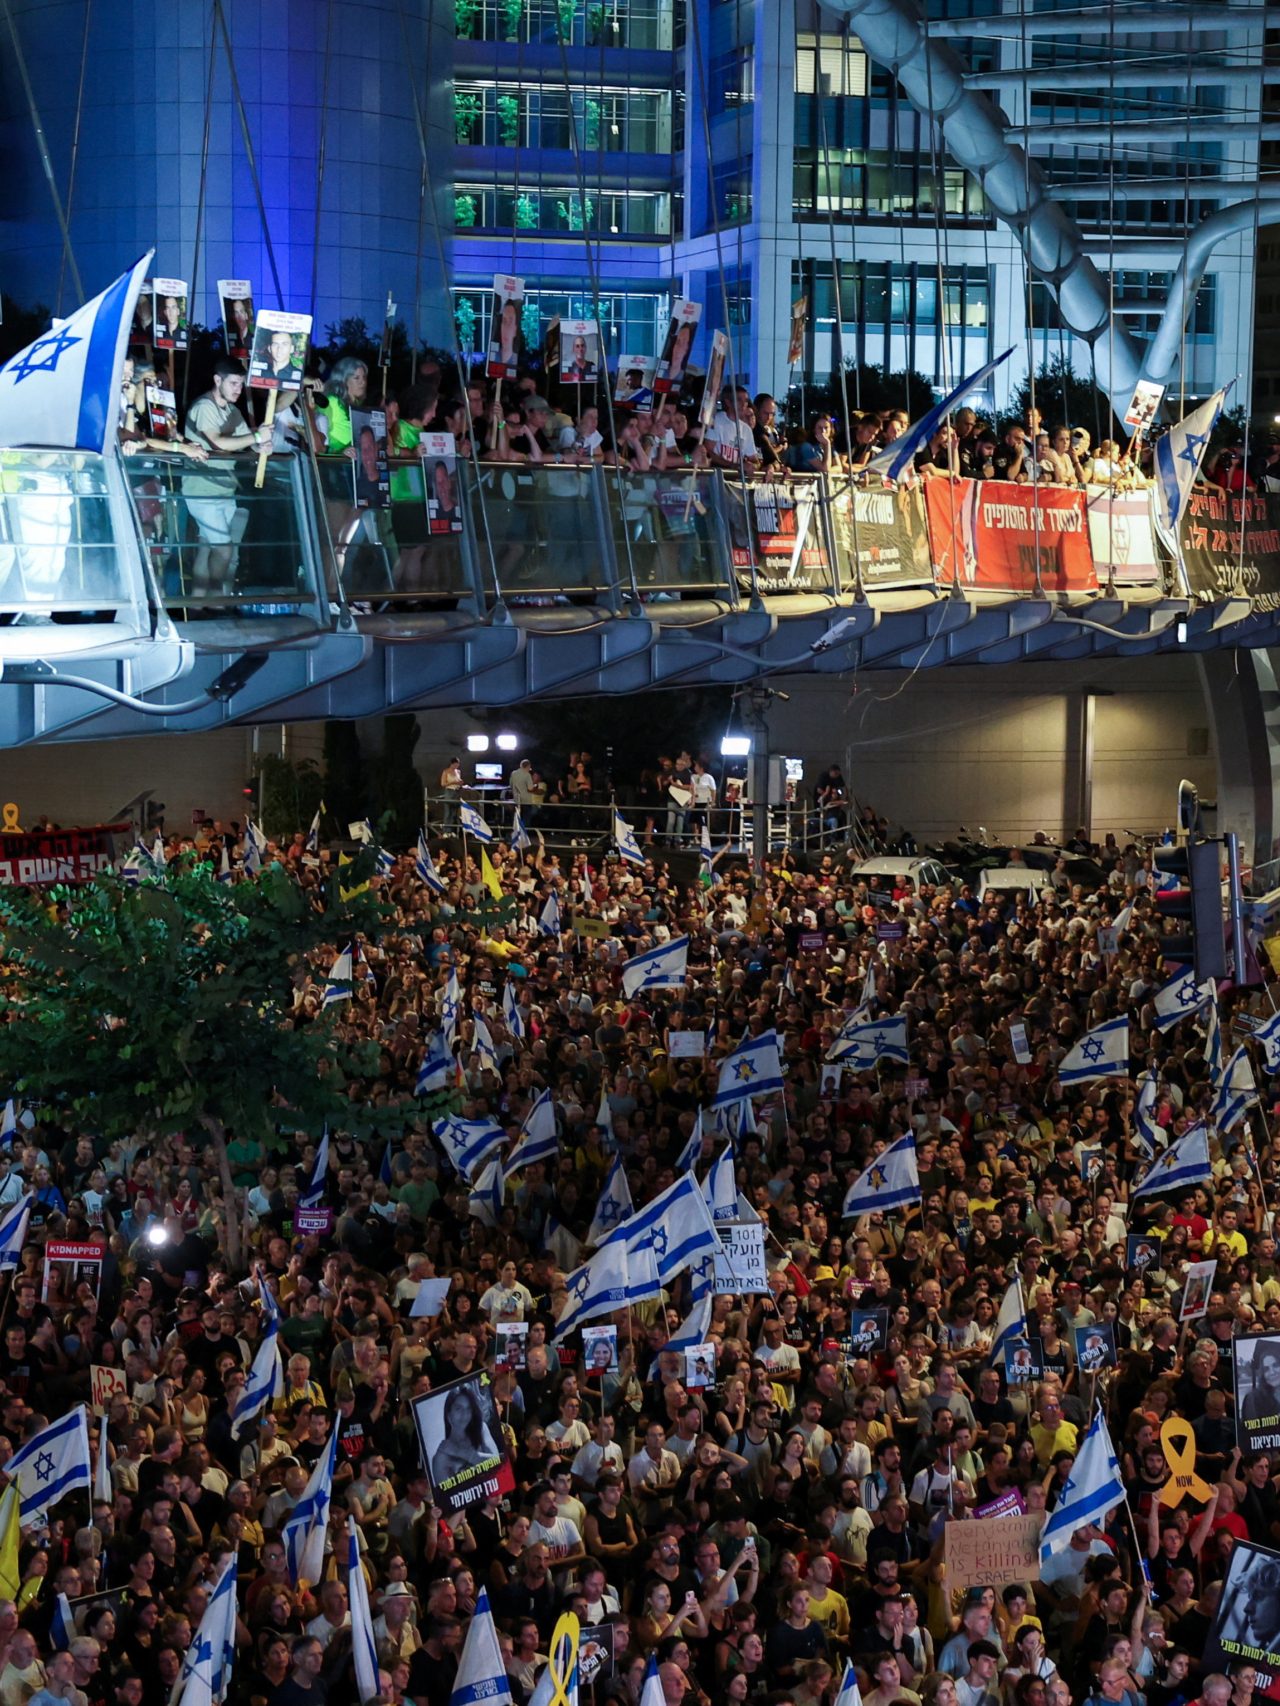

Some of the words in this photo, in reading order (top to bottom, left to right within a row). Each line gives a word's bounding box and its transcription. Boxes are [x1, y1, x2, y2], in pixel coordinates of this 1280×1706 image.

[983, 502, 1028, 531] החטופים
[1030, 507, 1046, 532] את
[18, 855, 76, 884] אשם
[300, 1219, 326, 1227] עכשיו
[736, 1229, 756, 1241] 101
[49, 1244, 101, 1256] KIDNAPPED
[82, 1265, 94, 1275] ME
[746, 1258, 760, 1268] מן
[1244, 1418, 1261, 1431] בשבי
[1262, 1414, 1279, 1428] למוות
[1250, 1433, 1280, 1450] מרציאנו
[438, 1476, 457, 1492] בשבי
[457, 1466, 478, 1486] למוות
[450, 1483, 483, 1508] ירושלמי
[484, 1477, 500, 1497] עדן
[949, 1519, 1038, 1541] Benjamin
[950, 1537, 1037, 1557] Netanyah
[963, 1568, 1025, 1587] ISRAEL
[599, 1646, 609, 1660] מר
[1220, 1638, 1240, 1655] בשבי
[1241, 1644, 1265, 1661] למוות
[472, 1679, 498, 1692] חופשי
